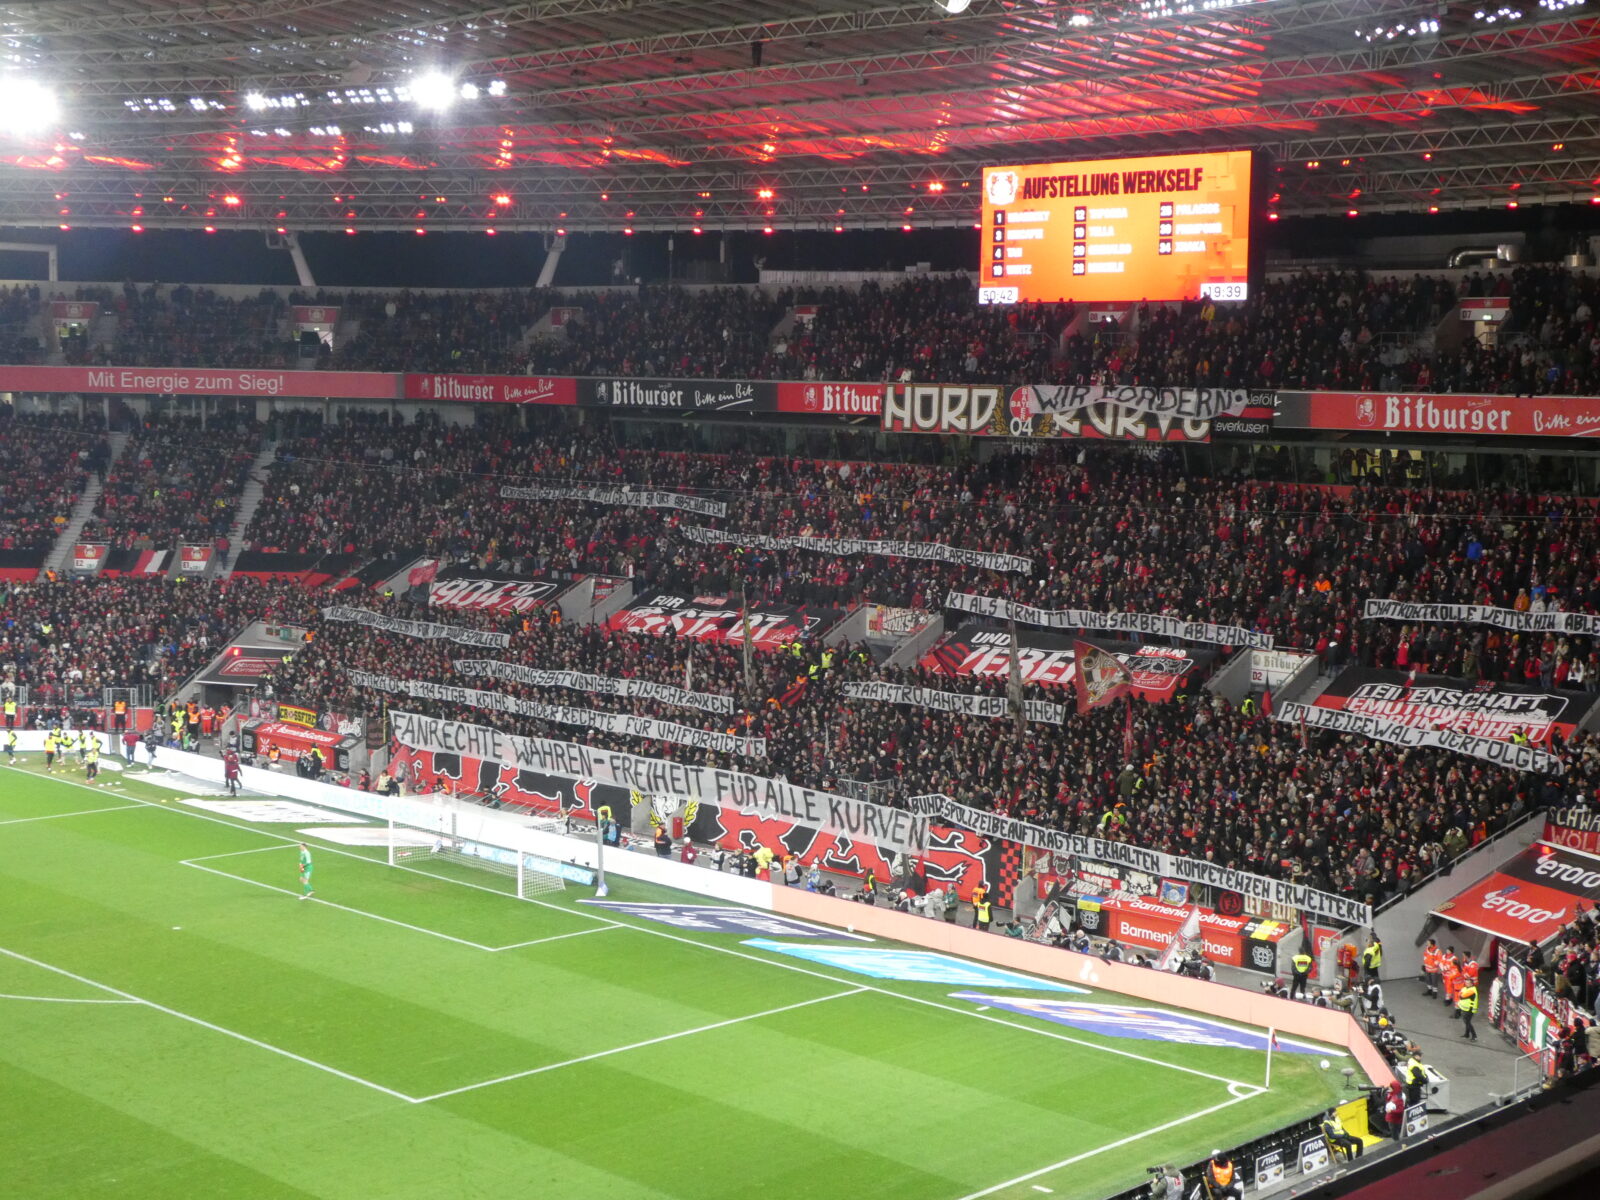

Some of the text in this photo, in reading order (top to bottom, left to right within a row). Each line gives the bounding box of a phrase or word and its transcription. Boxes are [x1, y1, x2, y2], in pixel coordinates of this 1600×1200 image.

[1023, 168, 1204, 199] AUFSTELLUNG WERKSELF
[982, 290, 1013, 302] 50:42
[88, 372, 284, 394] Mit Energie zum Sieg!
[433, 376, 494, 400] Bitburger
[612, 381, 684, 407] Bitburger
[694, 383, 755, 407] Bitte ein Bit
[884, 385, 999, 431] NORD
[1032, 386, 1091, 412] WIR
[1384, 396, 1512, 431] Bitburger
[1533, 409, 1571, 432] Bitte
[1010, 420, 1033, 437] 04
[1214, 420, 1269, 433] everkusen
[880, 542, 906, 556] FÜR
[649, 595, 685, 608] FÜR
[949, 593, 1271, 649] KI ALS ERMITTLUNGSARBEIT ABLEHNEN
[1367, 601, 1478, 621] CHATKONTROLLE
[1480, 607, 1556, 630] WEITERHIN
[970, 632, 1012, 646] UND
[1252, 671, 1262, 681] D2
[627, 681, 730, 712] EINSCHRÄNKEN
[843, 682, 1064, 723] STAATSTROJANER ABLHNEN
[476, 692, 509, 710] KEINE
[625, 716, 652, 735] FÜR
[1281, 706, 1430, 745] POLIZEIGEWALT
[393, 714, 504, 758] FANRECHTE
[610, 755, 704, 798] FREIHEIT
[714, 771, 758, 807] FÜR
[764, 781, 825, 822] ALLE
[829, 798, 926, 850] KURVEN
[1080, 861, 1119, 879] YOUNG
[1095, 841, 1160, 873] ERHALTEN
[1275, 885, 1368, 924] ERWEITERN
[1304, 1140, 1324, 1154] STIGA
[1261, 1155, 1280, 1167] STIGA
